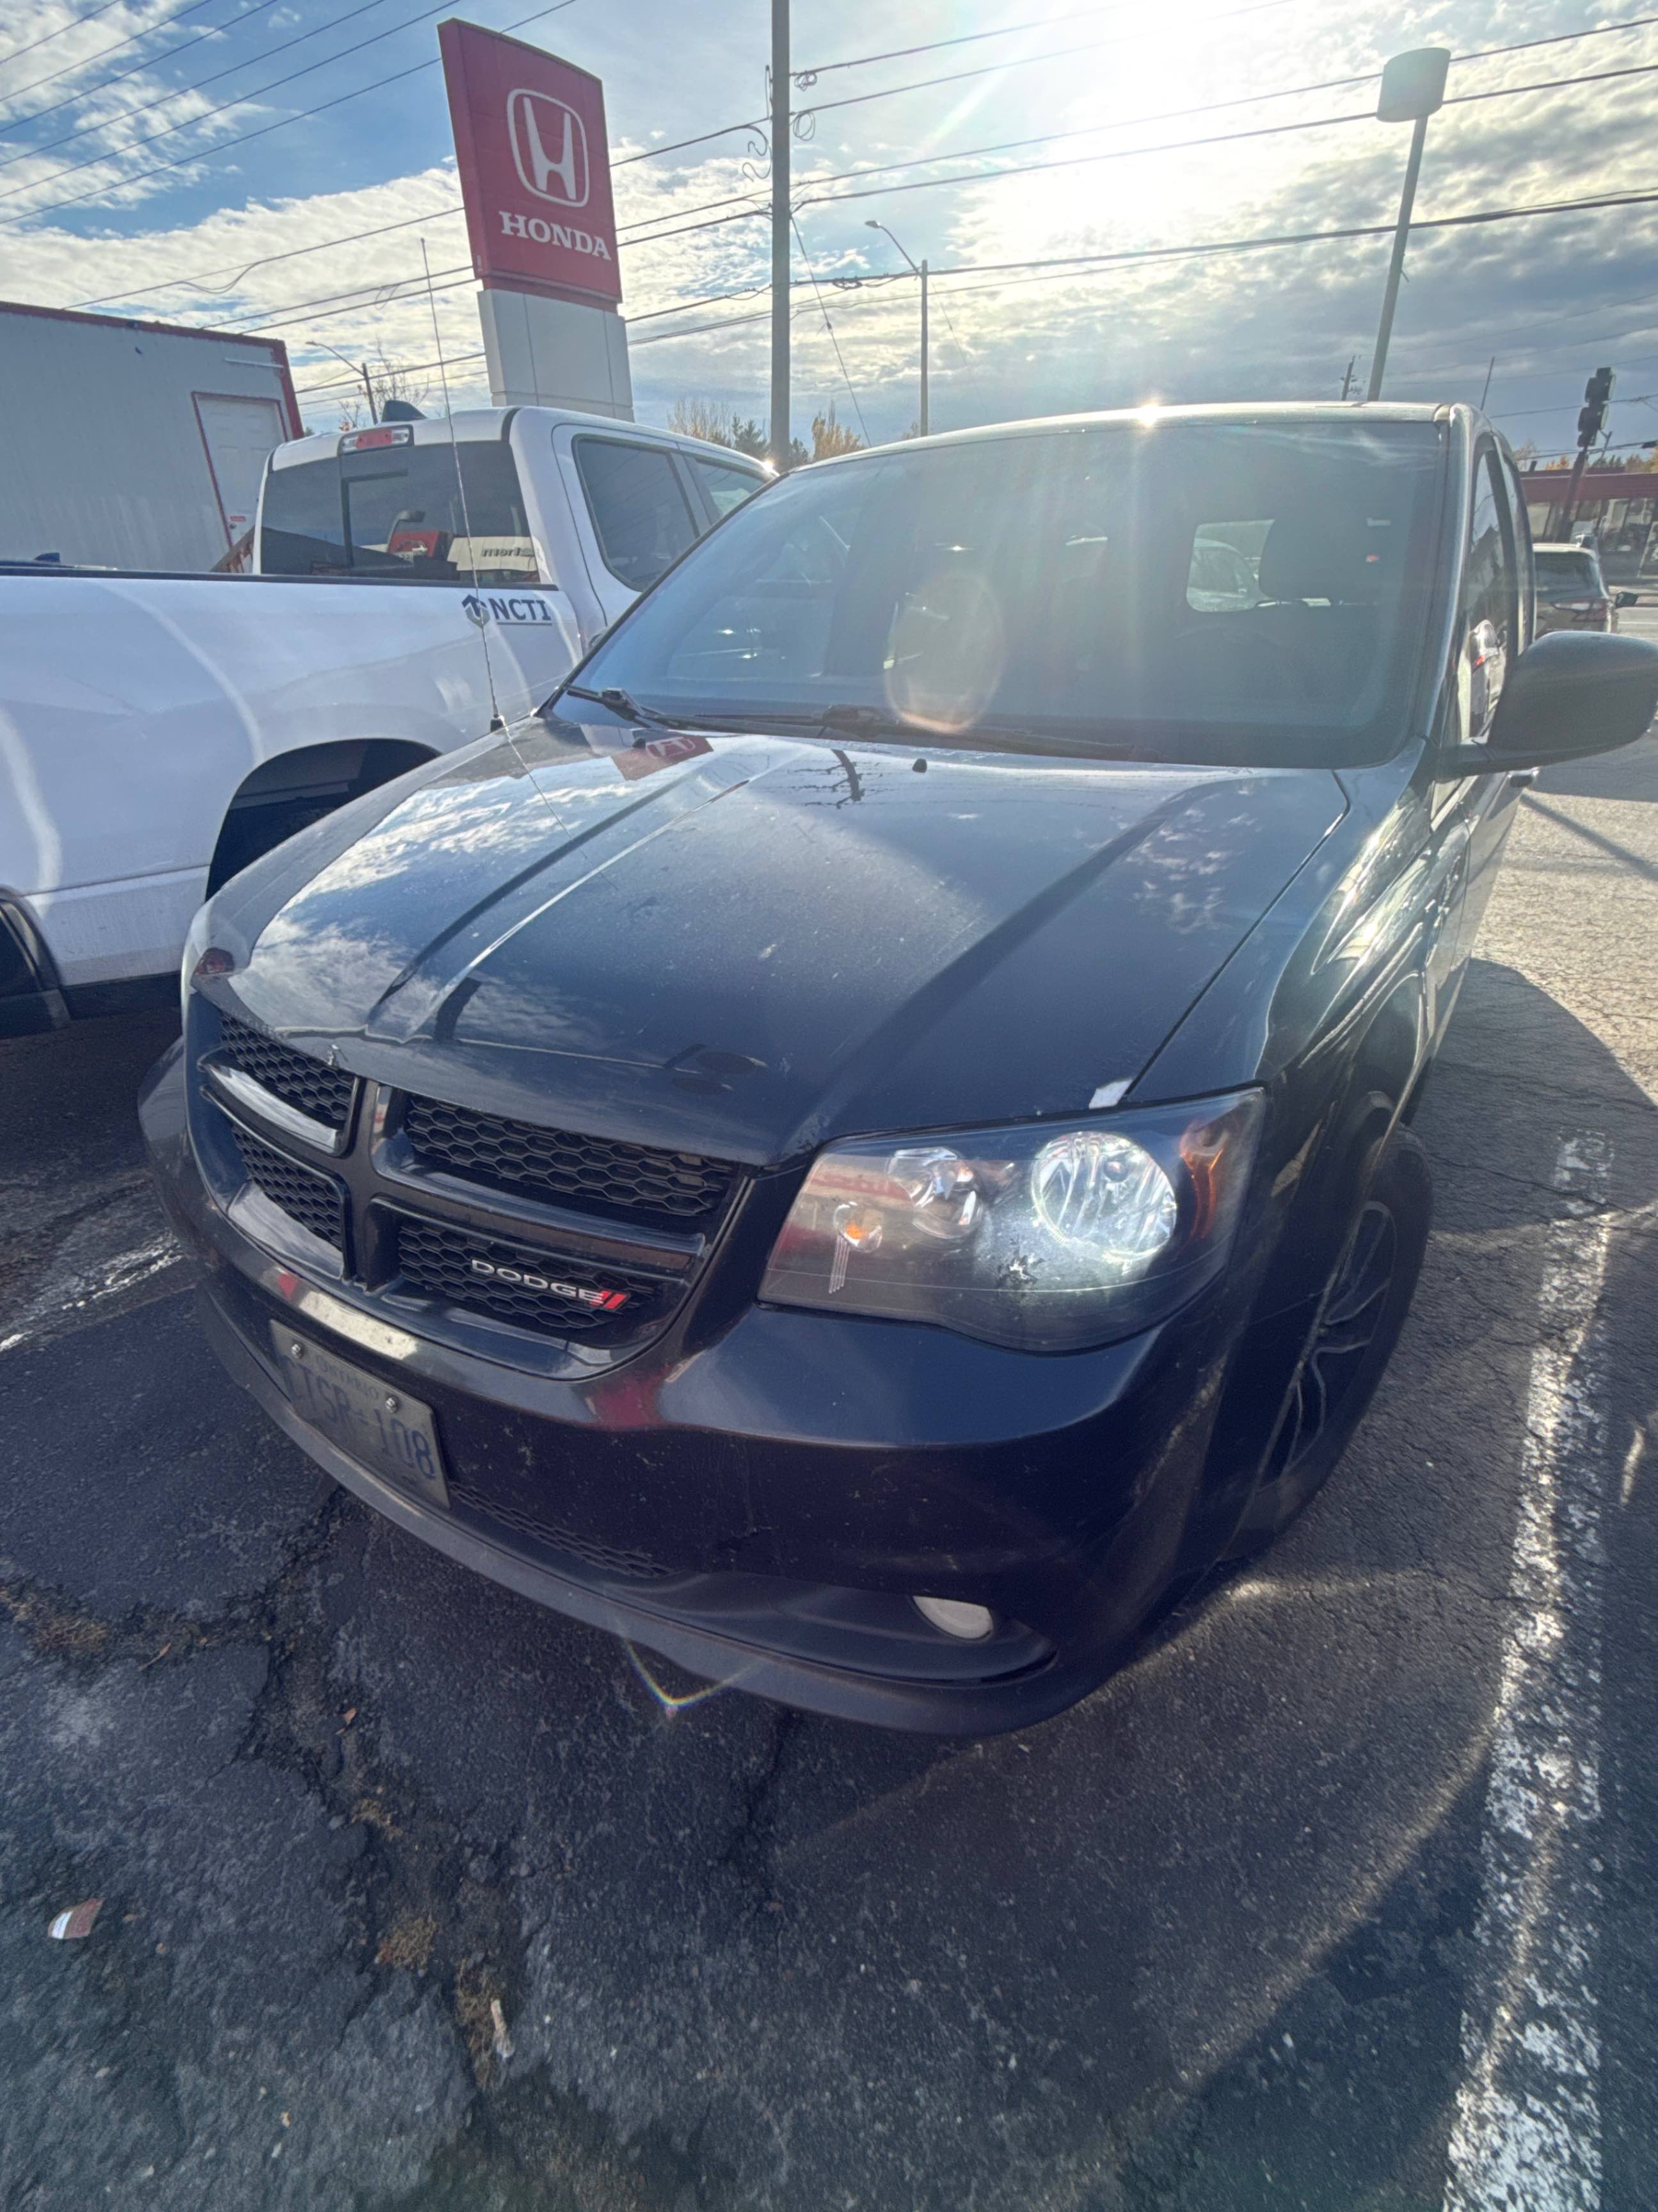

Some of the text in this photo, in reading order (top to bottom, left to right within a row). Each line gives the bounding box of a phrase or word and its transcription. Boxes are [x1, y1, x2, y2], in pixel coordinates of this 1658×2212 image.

[498, 211, 612, 260] HONDA
[488, 598, 552, 621] NCTI
[472, 1259, 603, 1304] DODGE
